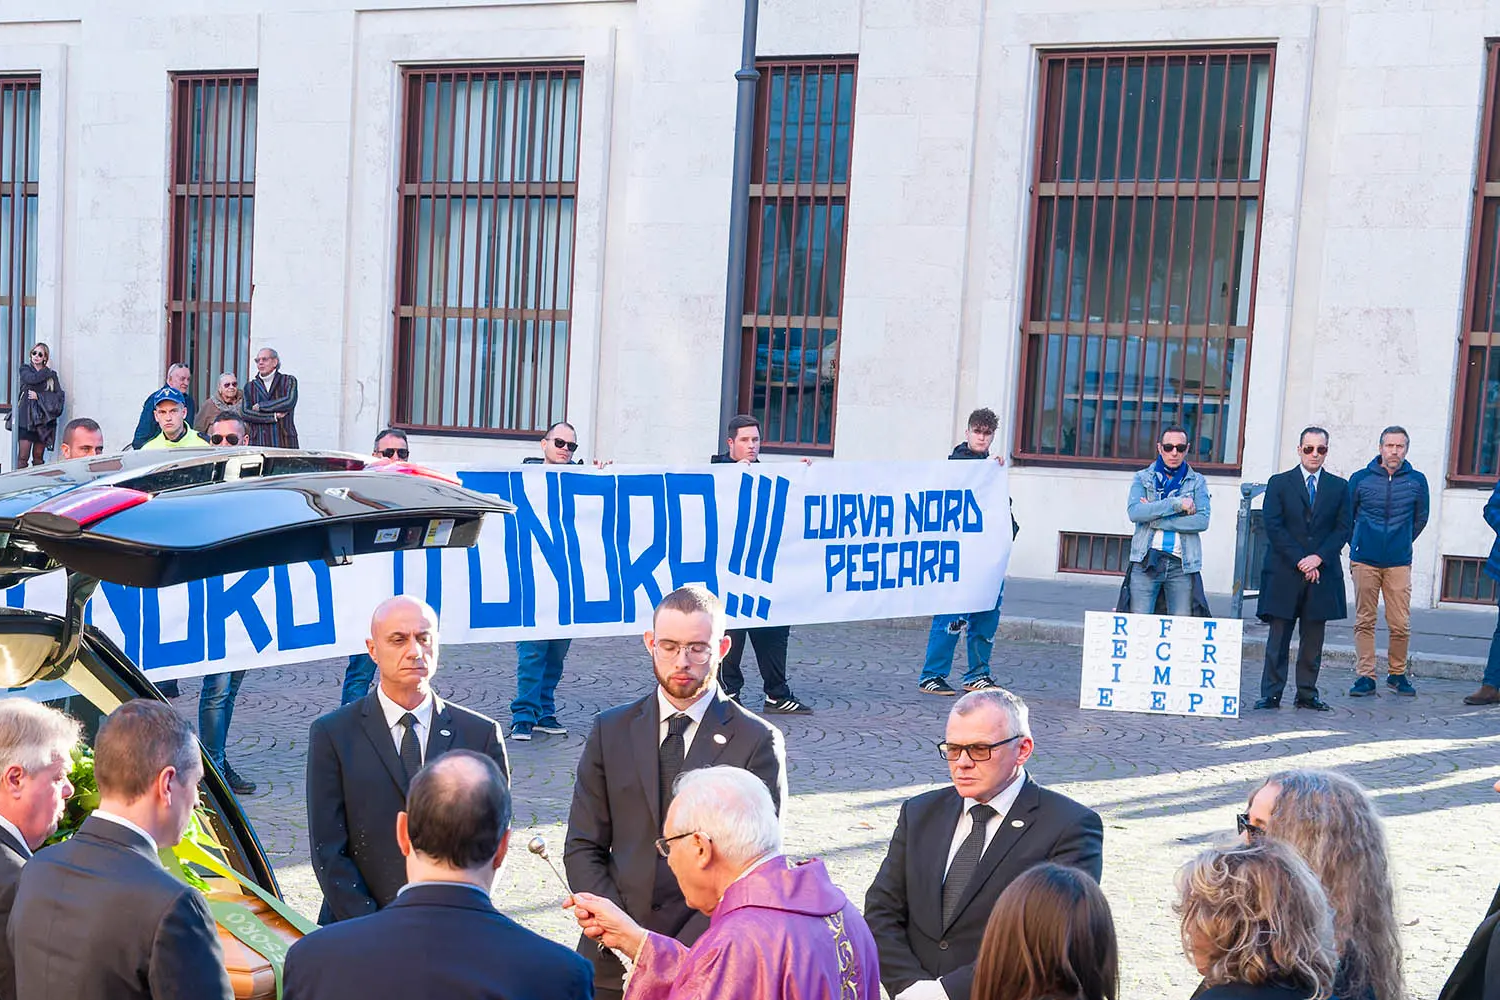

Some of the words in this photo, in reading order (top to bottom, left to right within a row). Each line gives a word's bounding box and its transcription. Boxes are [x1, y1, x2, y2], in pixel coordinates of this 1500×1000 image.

[803, 493, 895, 540] CURVA
[904, 489, 984, 536] NORD
[824, 540, 961, 593] PESCARA
